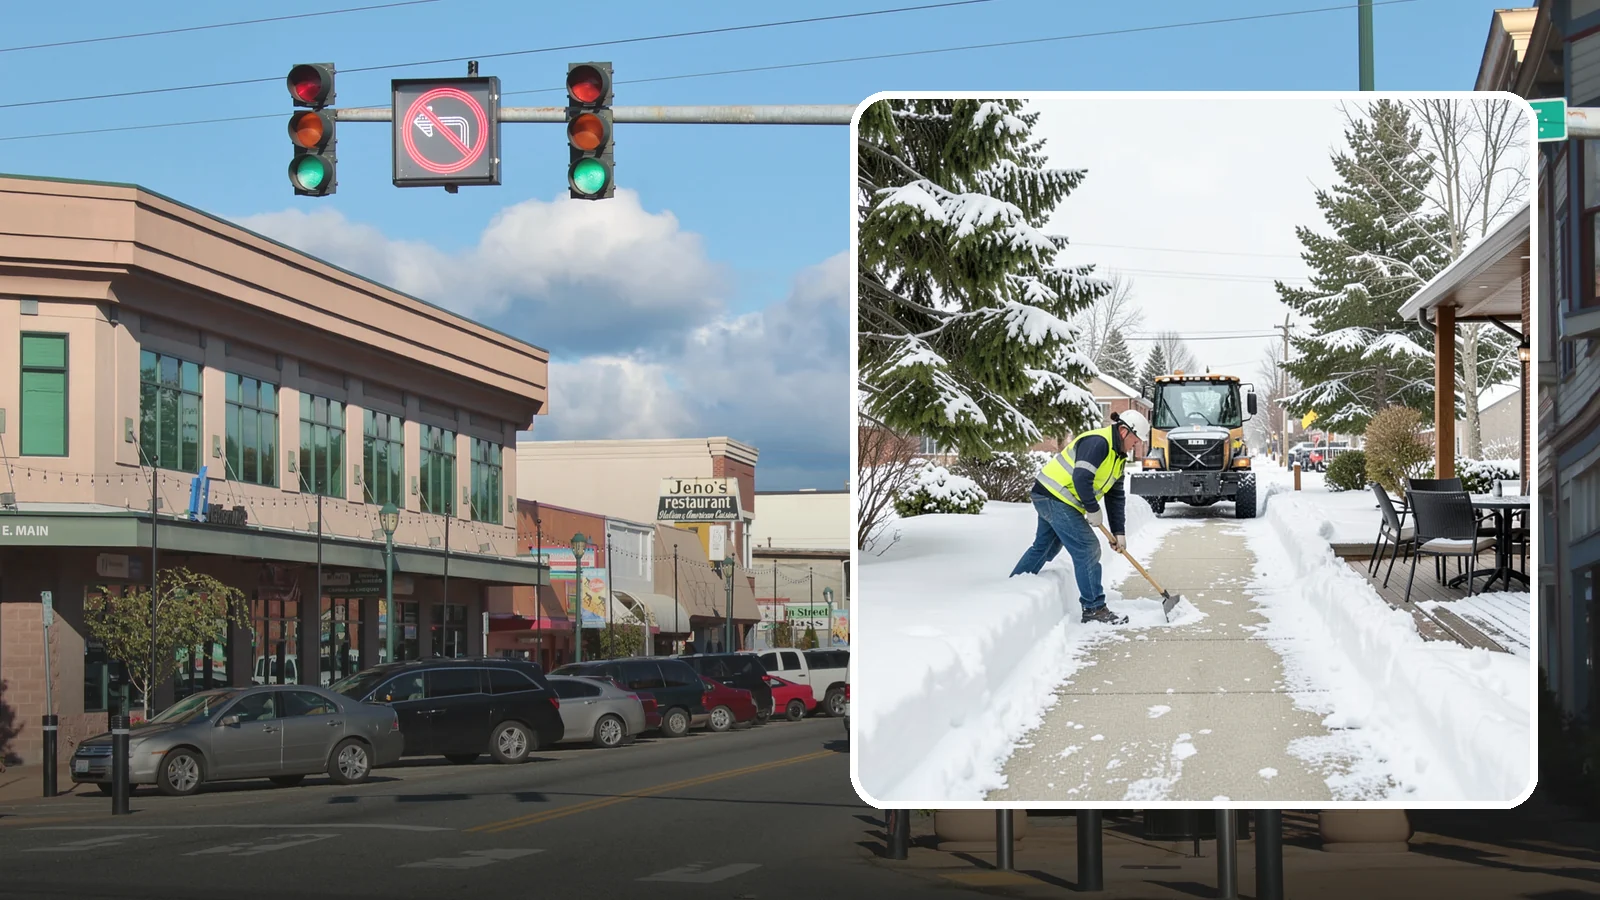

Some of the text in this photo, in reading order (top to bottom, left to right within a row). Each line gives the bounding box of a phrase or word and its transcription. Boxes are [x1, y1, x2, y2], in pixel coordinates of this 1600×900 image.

[669, 480, 727, 494] Jeno's
[665, 497, 731, 509] restaurant
[686, 510, 714, 519] American
[715, 509, 737, 519] Cuisine
[2, 525, 49, 536] E. MAIN
[797, 608, 828, 617] Street
[790, 619, 823, 627] lass
